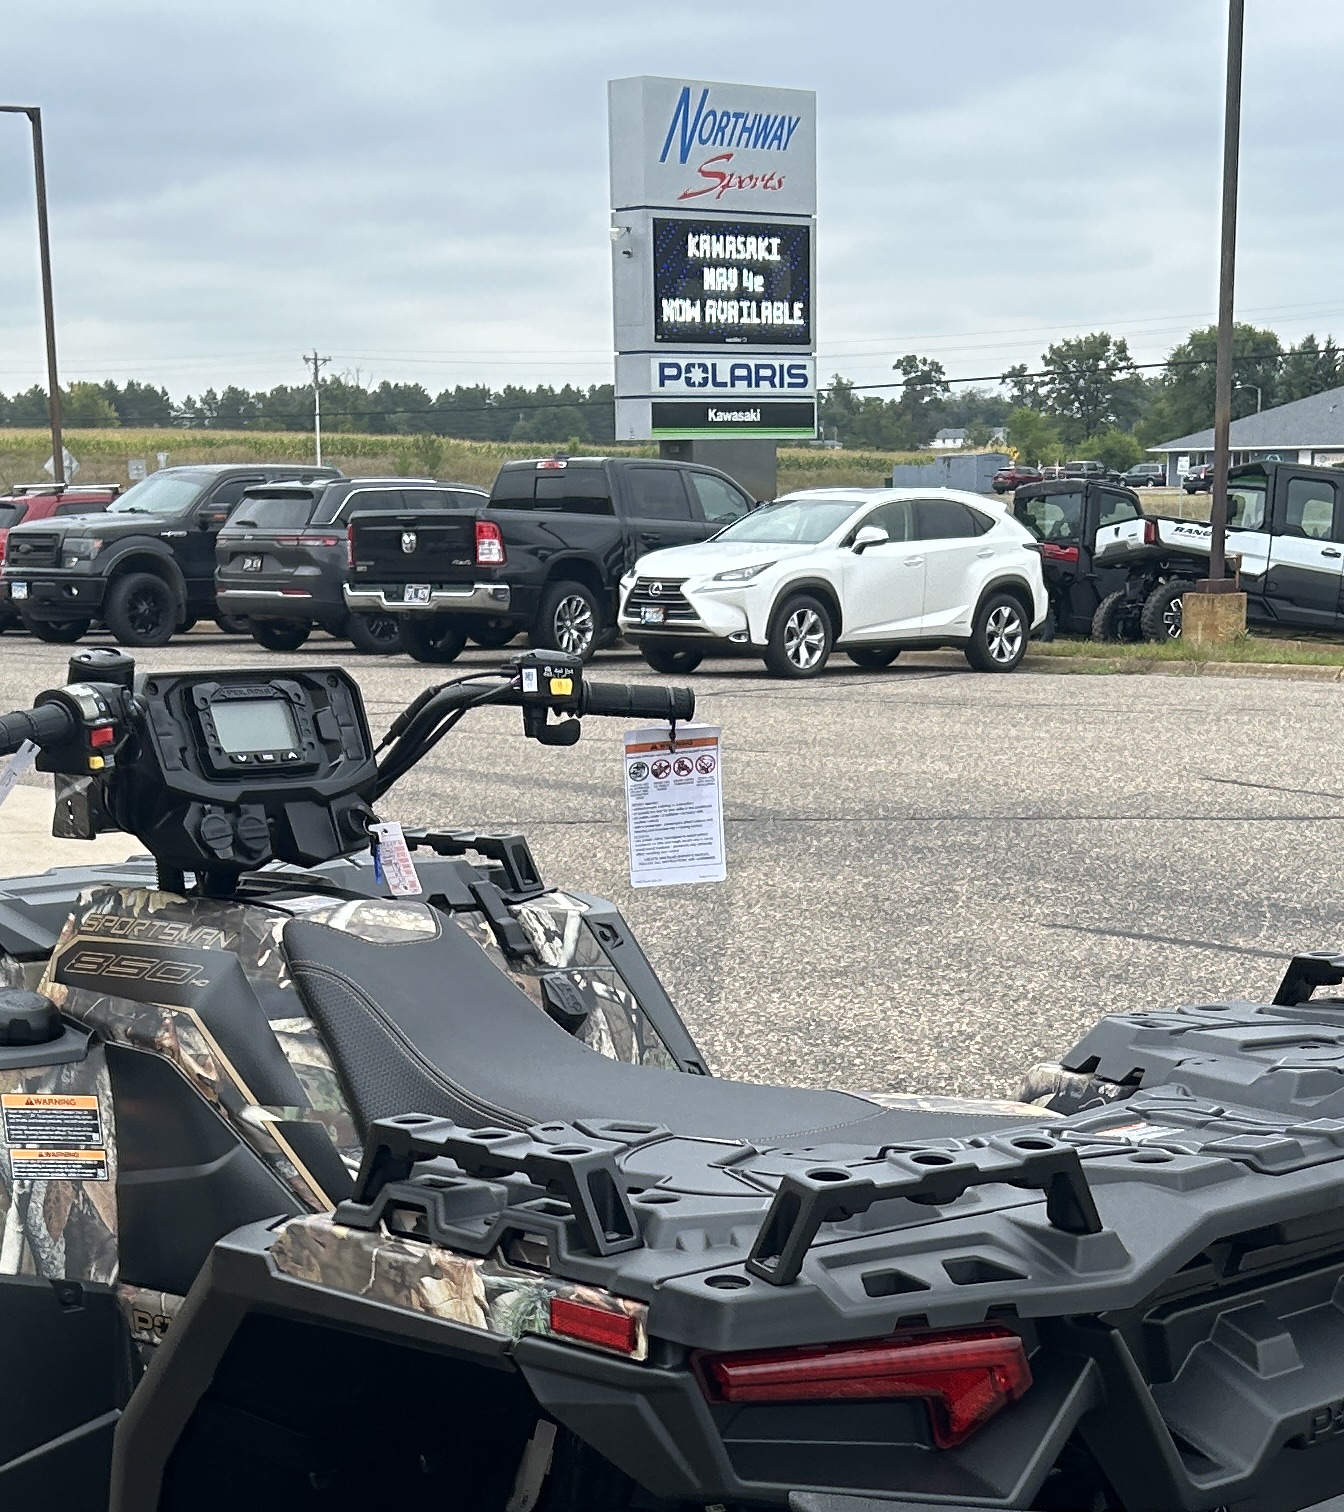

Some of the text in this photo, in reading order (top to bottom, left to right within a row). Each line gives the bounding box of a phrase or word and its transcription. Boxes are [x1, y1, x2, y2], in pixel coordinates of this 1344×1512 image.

[659, 87, 801, 164] NORTHWAY
[677, 152, 786, 200] Sports
[687, 232, 781, 261] KAWASAKI
[661, 298, 805, 324] NOW AVAILABLE
[658, 362, 809, 389] POLARIS
[708, 408, 761, 422] Kawasaki
[80, 912, 240, 949] SPORTSMAN
[63, 950, 205, 985] 850
[34, 1098, 77, 1106] WARNING
